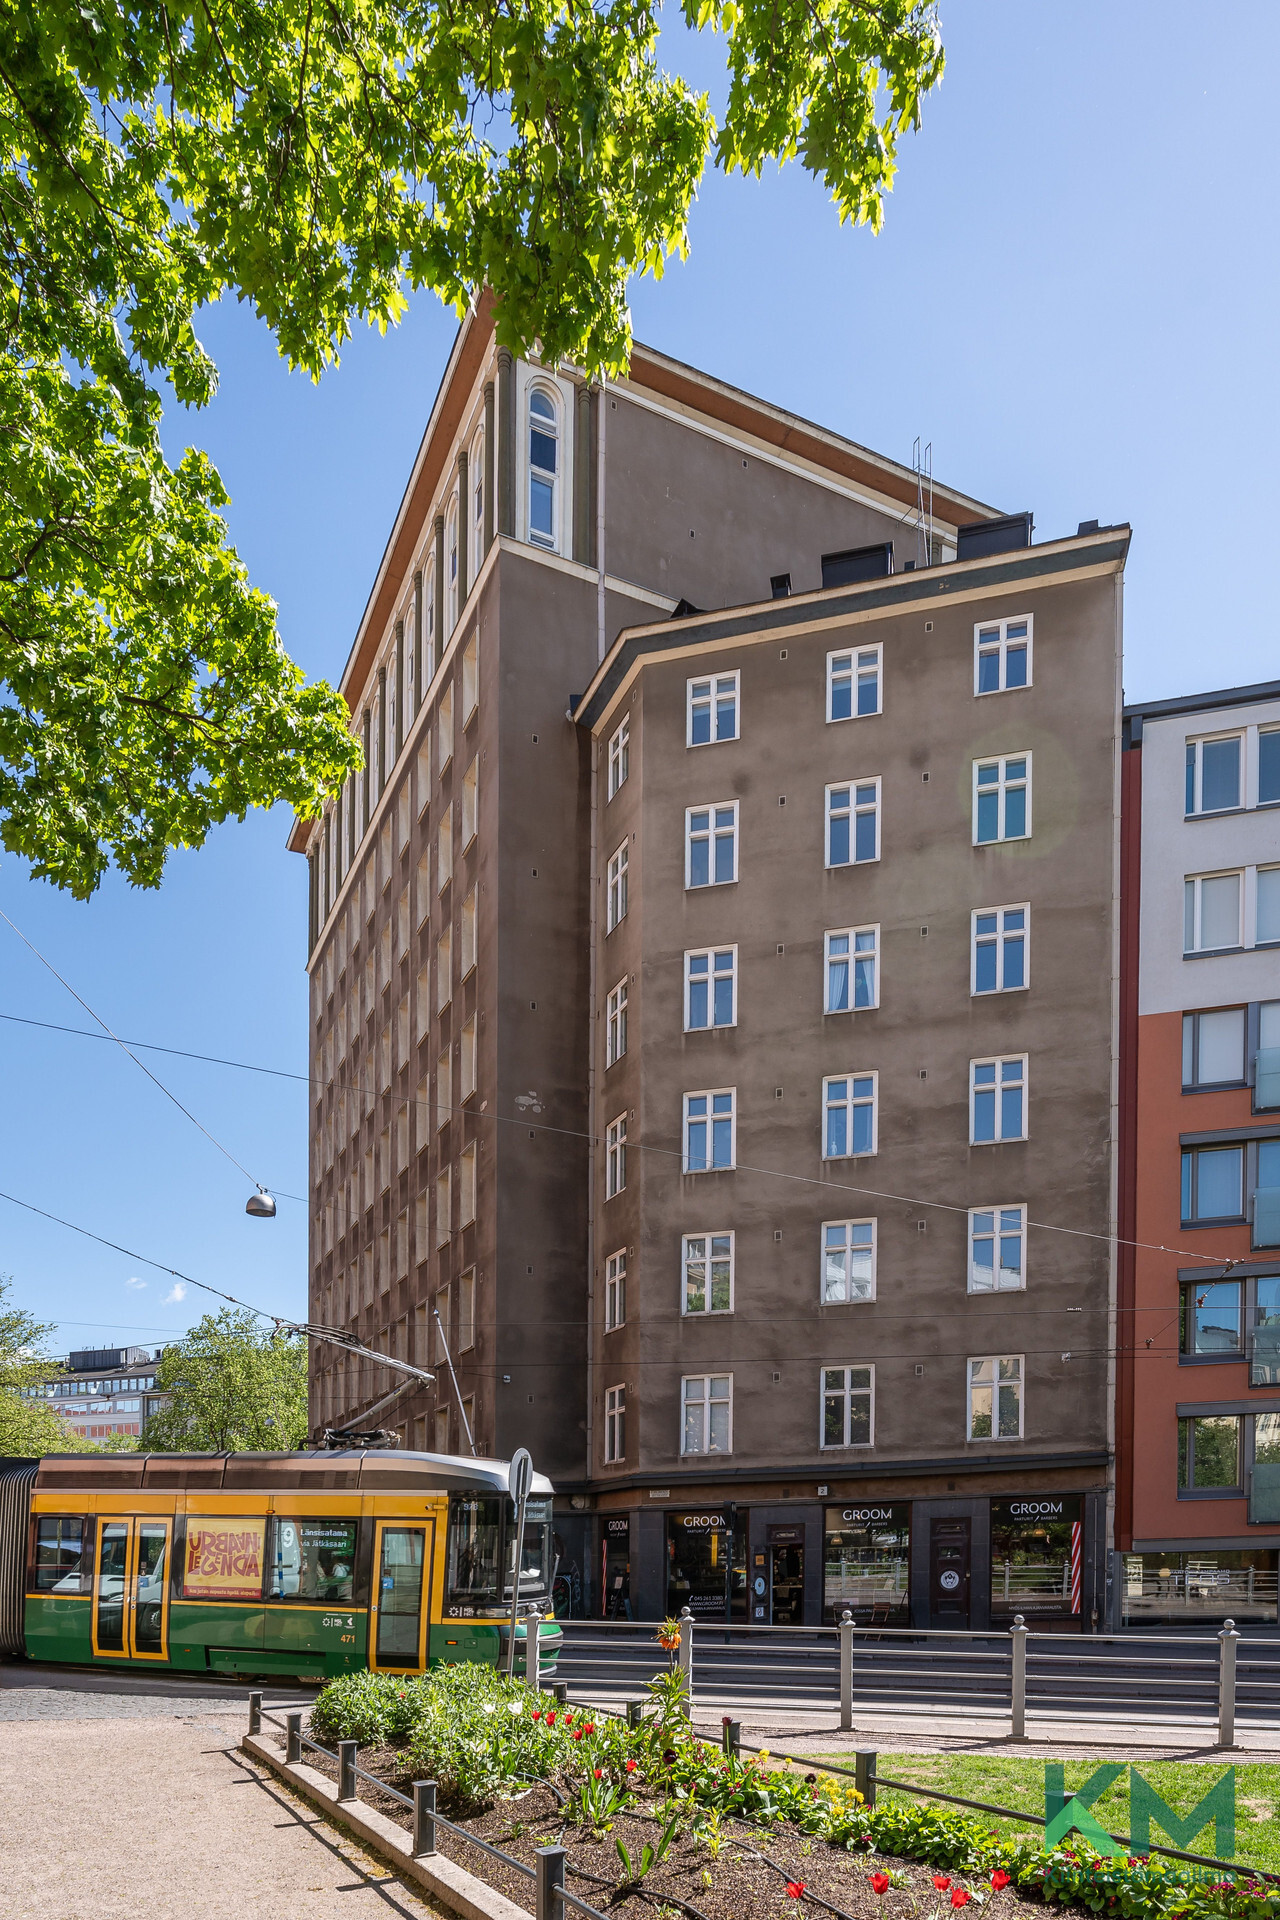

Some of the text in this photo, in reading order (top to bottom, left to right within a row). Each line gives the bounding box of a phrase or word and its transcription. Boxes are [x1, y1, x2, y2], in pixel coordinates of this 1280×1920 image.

[1010, 1501, 1063, 1515] GROOM
[842, 1508, 892, 1521] GROOM
[608, 1520, 628, 1531] GROOM
[283, 1527, 294, 1548] 9
[300, 1528, 348, 1537] Länsisatama
[311, 1540, 347, 1548] Jätkäsaari
[188, 1550, 260, 1578] LEGENDA
[340, 1634, 355, 1643] 471
